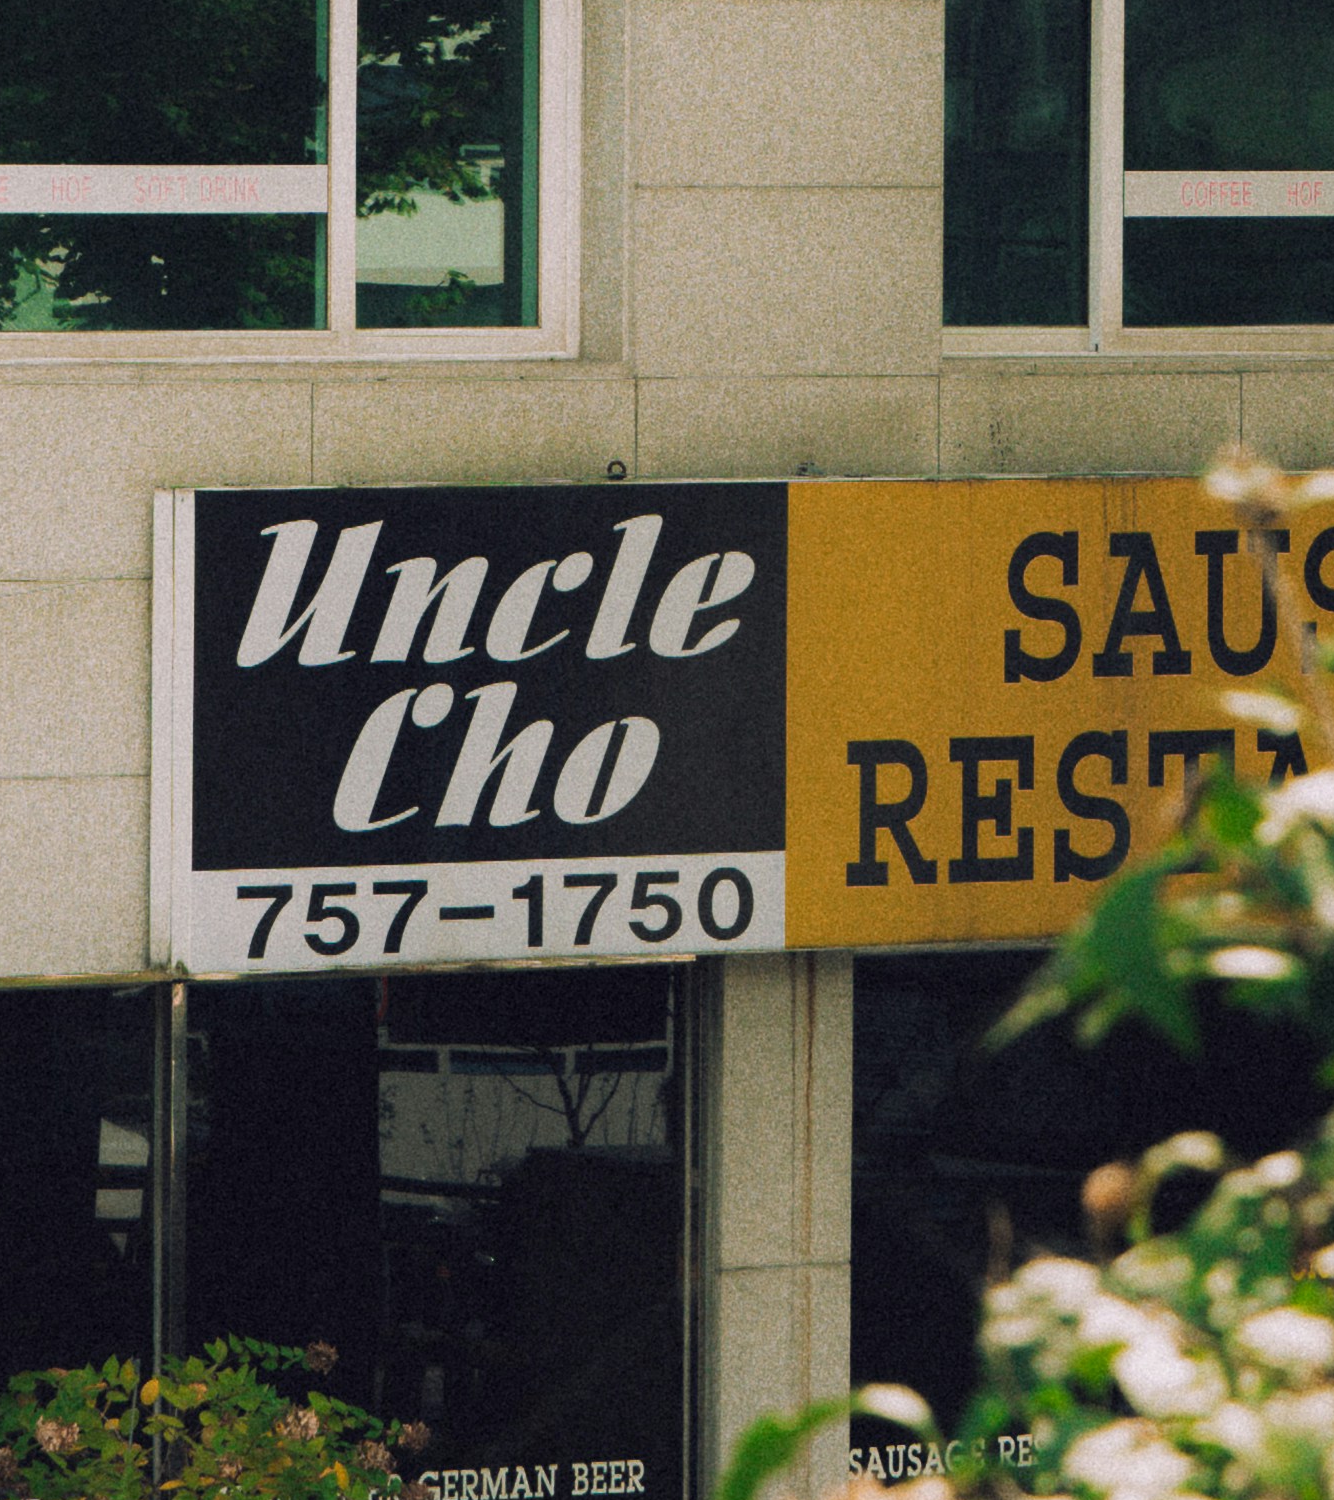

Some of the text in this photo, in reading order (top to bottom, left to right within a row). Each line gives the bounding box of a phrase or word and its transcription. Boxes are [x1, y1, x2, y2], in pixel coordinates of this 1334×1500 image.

[51, 175, 92, 202] HOF
[133, 174, 188, 203] SOFT
[199, 175, 260, 202] DRINK
[1180, 180, 1253, 208] COFFEE
[1286, 180, 1325, 208] HOF
[236, 513, 756, 668] Uncle
[332, 680, 661, 833] Cho
[236, 866, 756, 961] 757-1750
[571, 1459, 646, 1496] BEER
